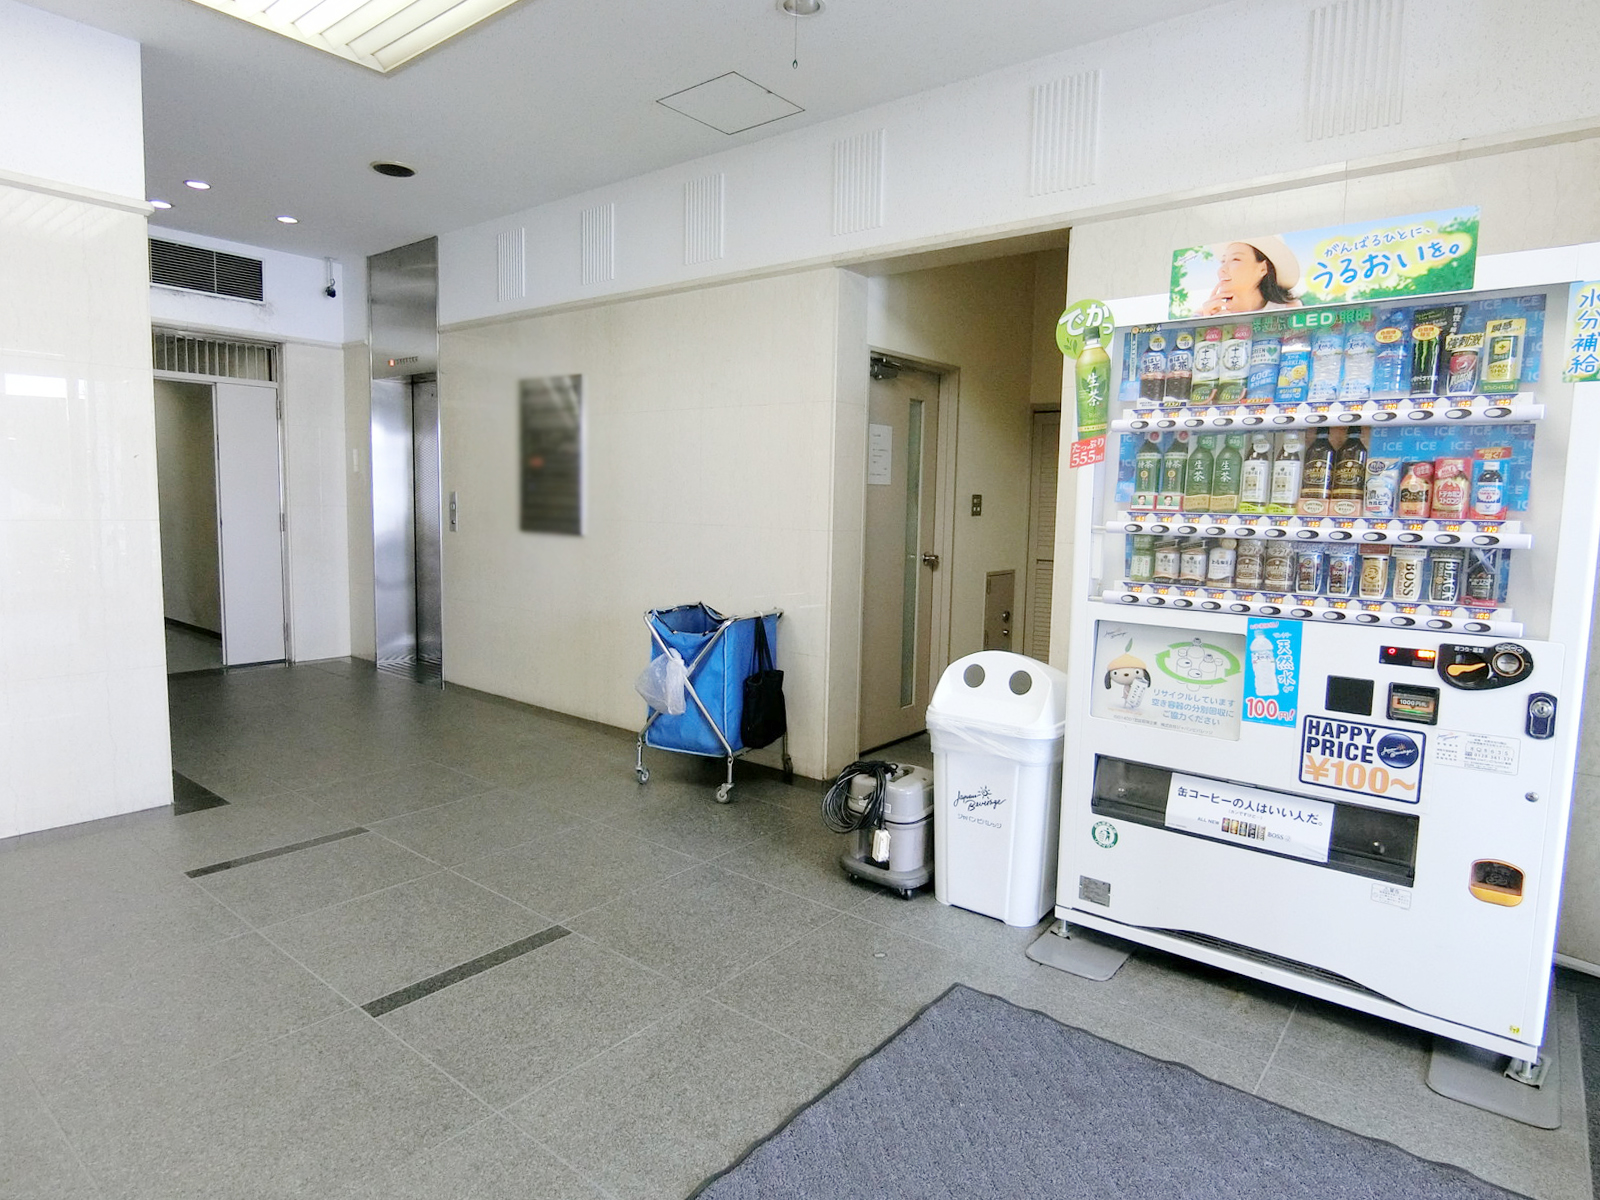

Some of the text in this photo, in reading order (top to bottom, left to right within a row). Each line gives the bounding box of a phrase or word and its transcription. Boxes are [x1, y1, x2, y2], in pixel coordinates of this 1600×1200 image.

[1324, 226, 1433, 257] がんばるひとに、
[1312, 242, 1461, 289] うるおいを。
[1058, 303, 1114, 336] でかっ
[1292, 307, 1371, 328] LED 照明
[1447, 333, 1484, 349] 強刺激
[1568, 288, 1600, 374] 水分補給
[1230, 347, 1240, 368] 十六茶
[1087, 372, 1103, 406] 生茶
[1372, 427, 1387, 437] CE
[1400, 426, 1421, 436] ICE
[1434, 425, 1455, 436] ICE
[1469, 425, 1492, 436] ICE
[1506, 425, 1529, 435] ICE
[1071, 437, 1105, 453] たっぷり
[1382, 441, 1403, 451] ICE
[1416, 441, 1437, 451] ICE
[1451, 440, 1473, 450] ICE
[1071, 449, 1104, 467] 555ml
[1193, 460, 1205, 482] 生茶
[1220, 460, 1232, 482] 生茶
[1439, 497, 1461, 506] ストロング
[1403, 562, 1416, 597] BOSS
[1442, 561, 1455, 602] BLACK
[1276, 639, 1296, 686] 天然水
[1153, 687, 1236, 708] リサイクルしています
[1151, 698, 1234, 719] 空き容器の分別回収に
[1162, 710, 1220, 727] ご協力ください
[1246, 697, 1296, 721] 100円!
[1308, 719, 1376, 744] HAPPY
[1306, 736, 1374, 764] PRICE
[1177, 786, 1323, 827] 缶コーヒーの人はいい人だ。
[1267, 831, 1284, 841] BOSS
